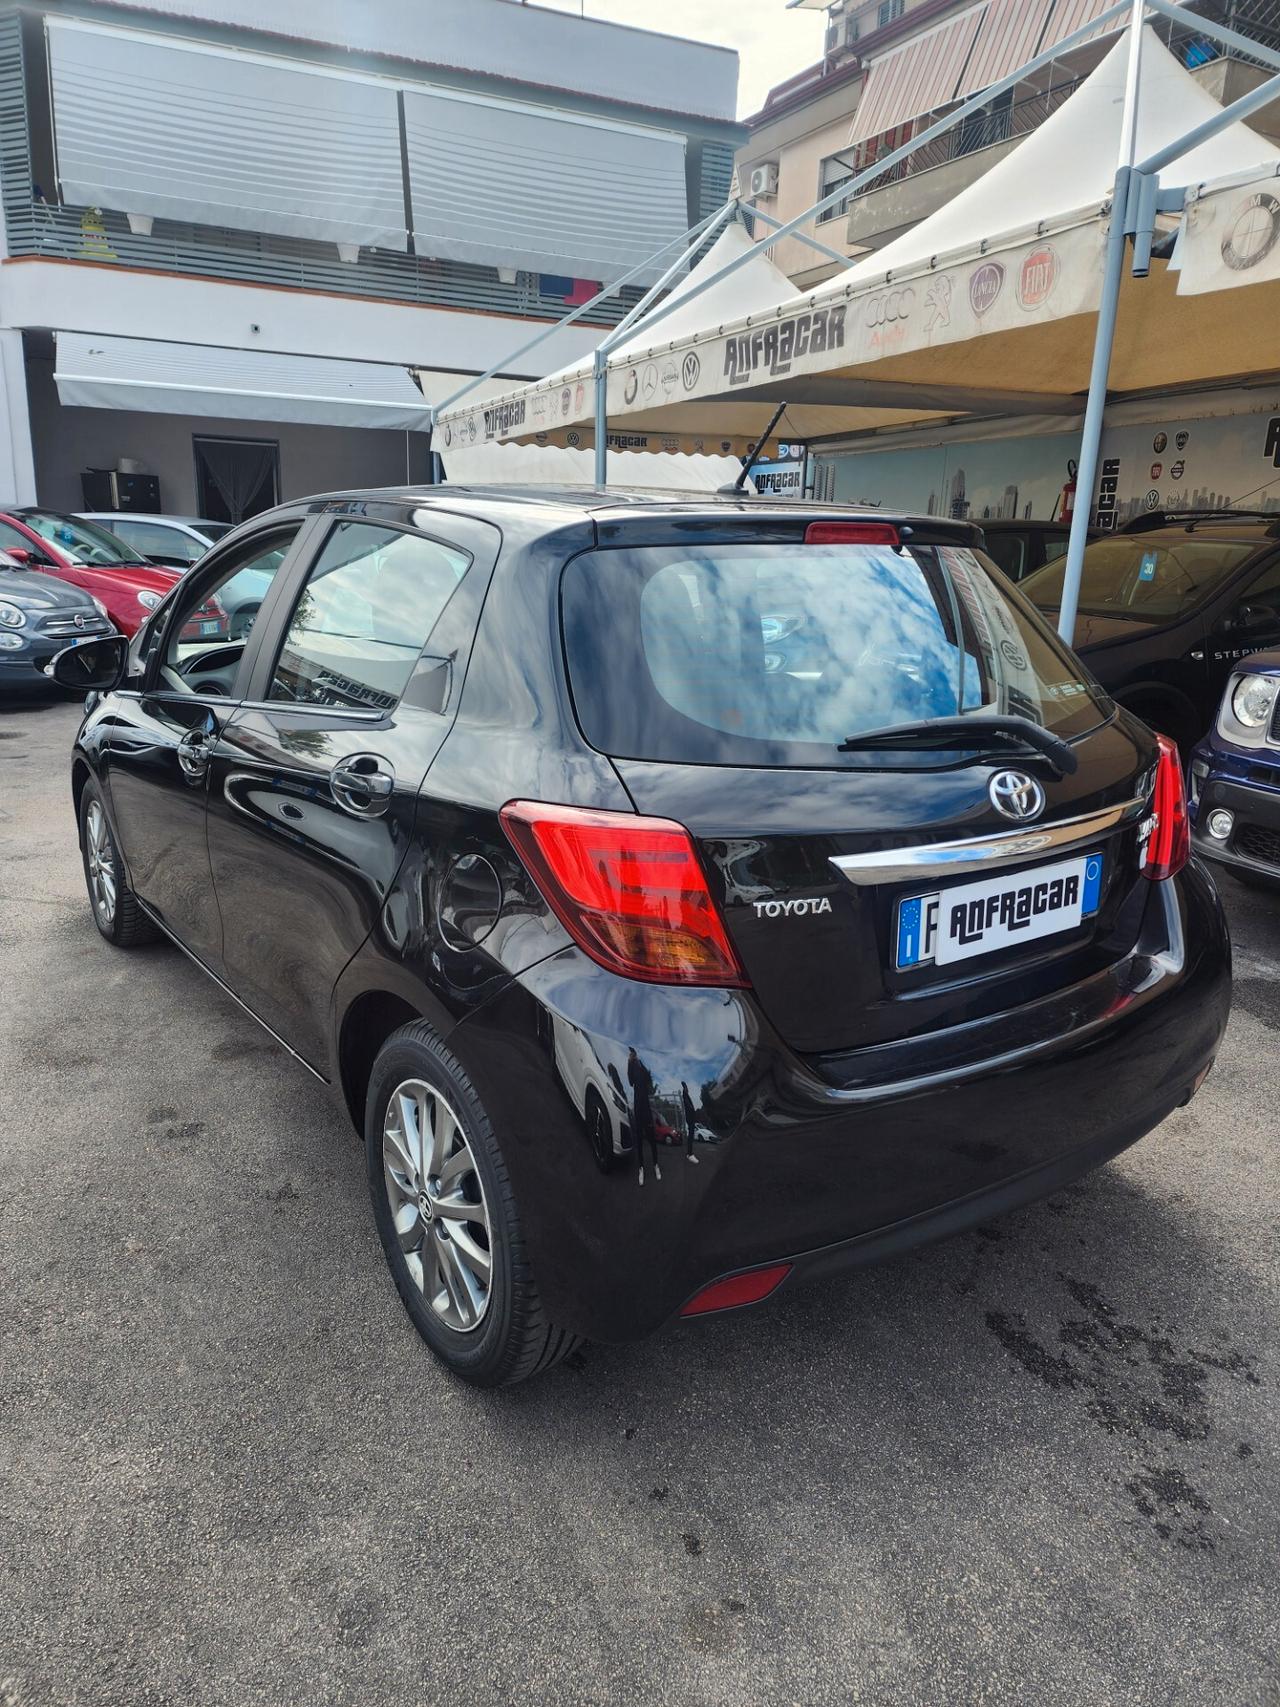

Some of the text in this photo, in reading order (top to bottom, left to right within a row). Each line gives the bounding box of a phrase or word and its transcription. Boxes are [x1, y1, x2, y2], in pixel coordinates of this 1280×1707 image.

[1025, 262, 1051, 293] FIAT
[724, 305, 847, 385] ANFRACAR
[755, 472, 800, 495] ANFRACAR
[753, 898, 832, 918] TOYOTA
[950, 875, 1080, 945] ANFRACAR
